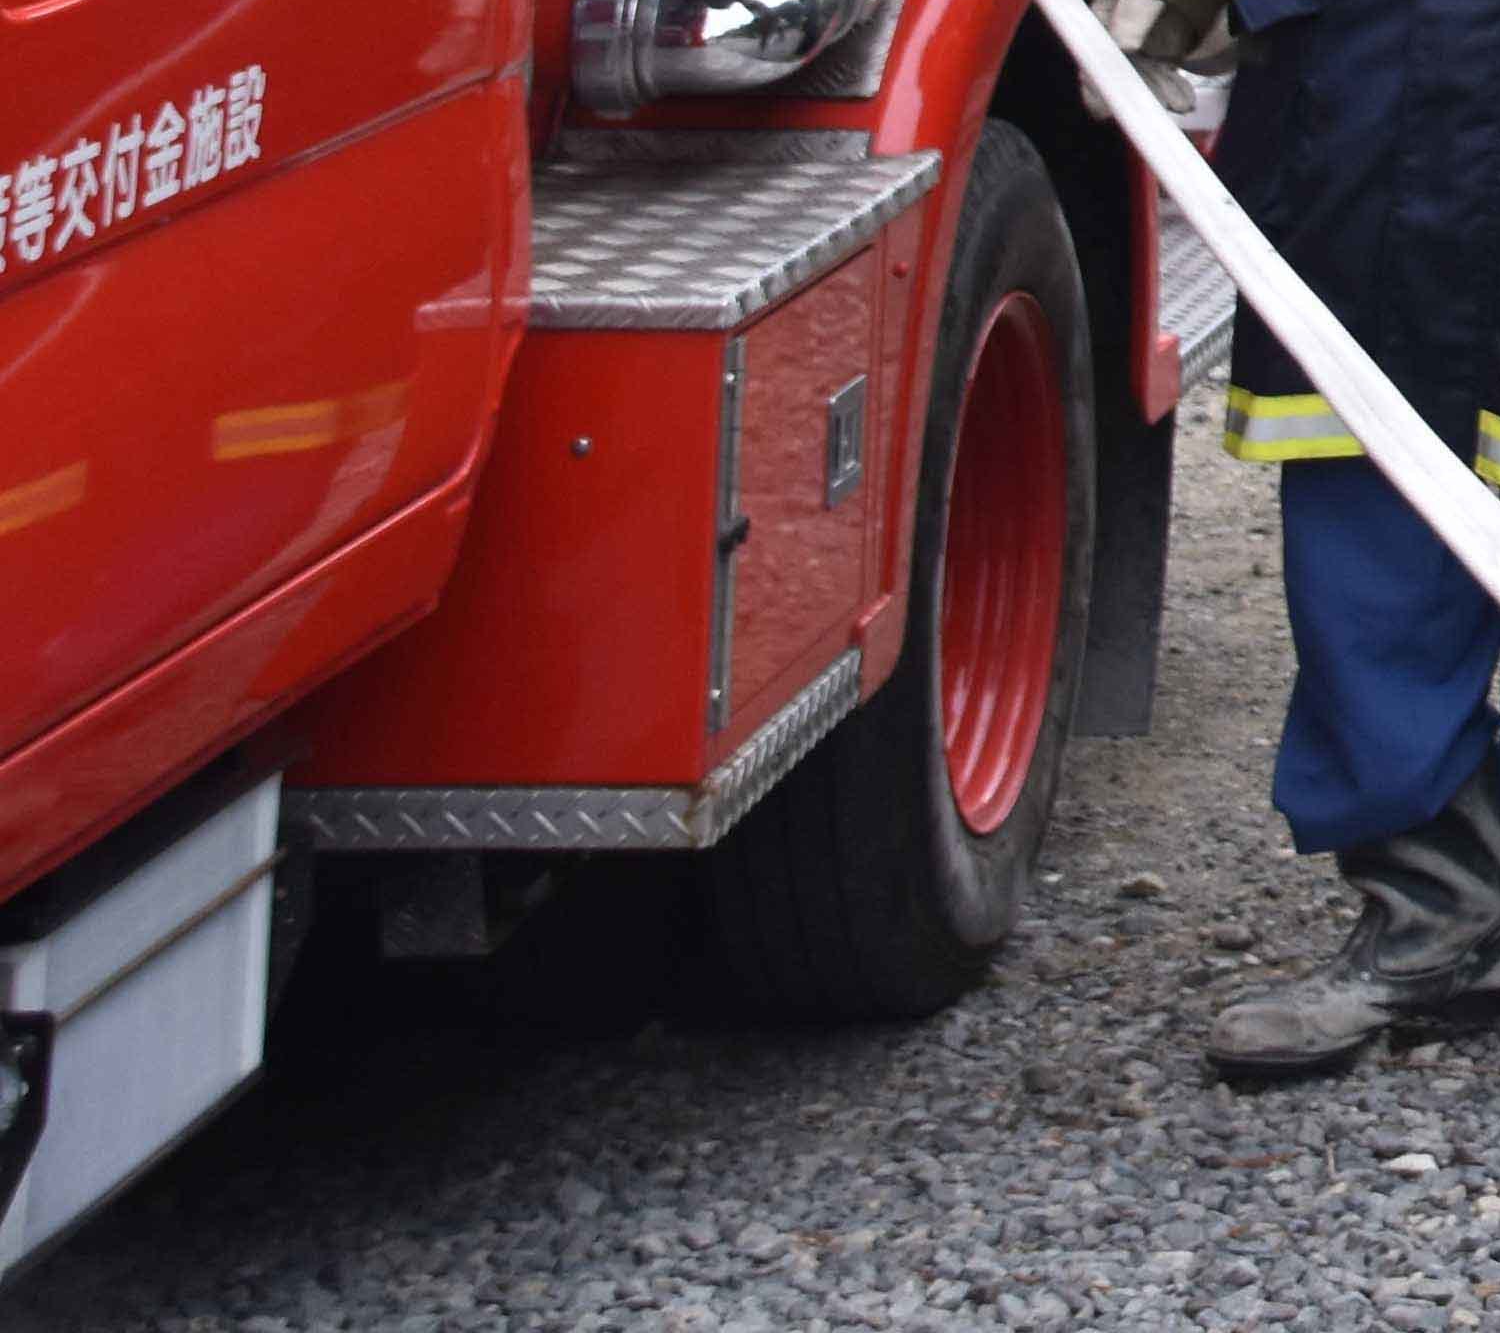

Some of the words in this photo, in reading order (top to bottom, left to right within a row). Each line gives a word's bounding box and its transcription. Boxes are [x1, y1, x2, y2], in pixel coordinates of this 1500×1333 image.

[0, 62, 269, 275] 等交付金施設
